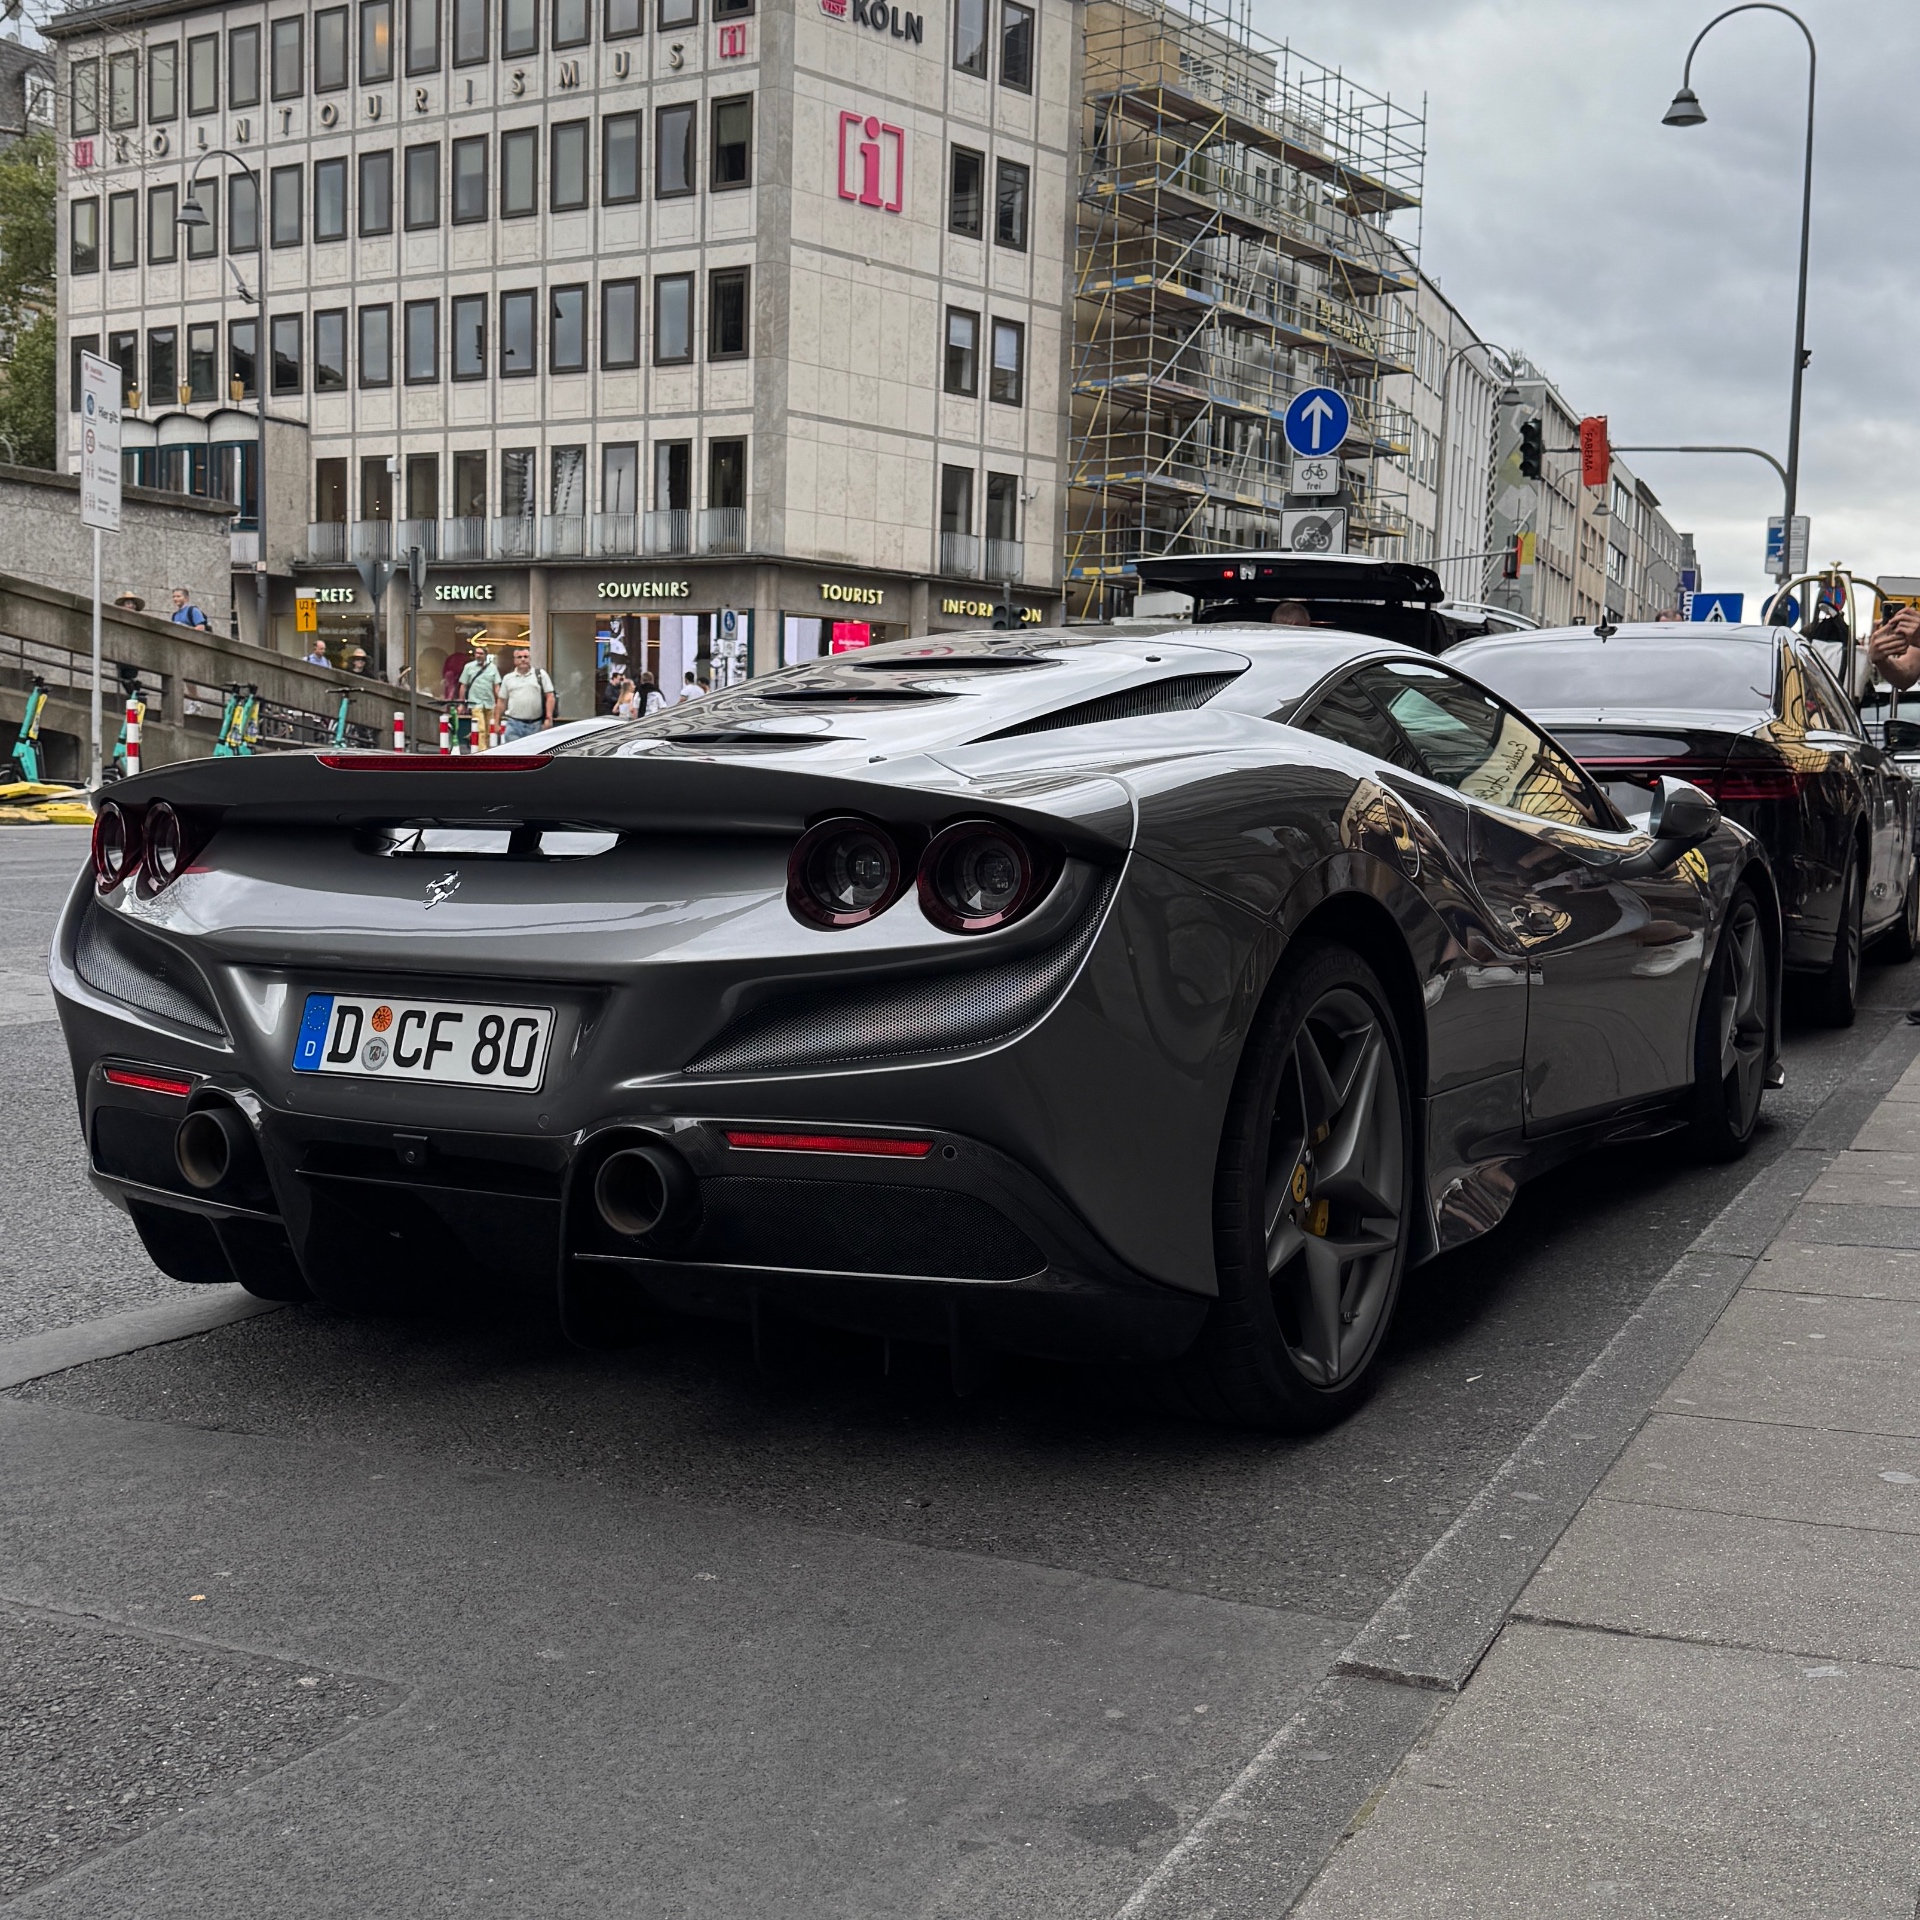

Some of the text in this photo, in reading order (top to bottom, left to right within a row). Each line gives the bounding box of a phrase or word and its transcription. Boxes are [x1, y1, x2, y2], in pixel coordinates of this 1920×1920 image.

[1584, 432, 1593, 472] FABEMA
[1306, 481, 1321, 490] frei
[435, 585, 493, 601] SERVICE
[597, 582, 690, 598] SOUVENIRS
[820, 583, 884, 605] TOURIST
[304, 1040, 317, 1057] D
[327, 1005, 541, 1077] D CF 80
